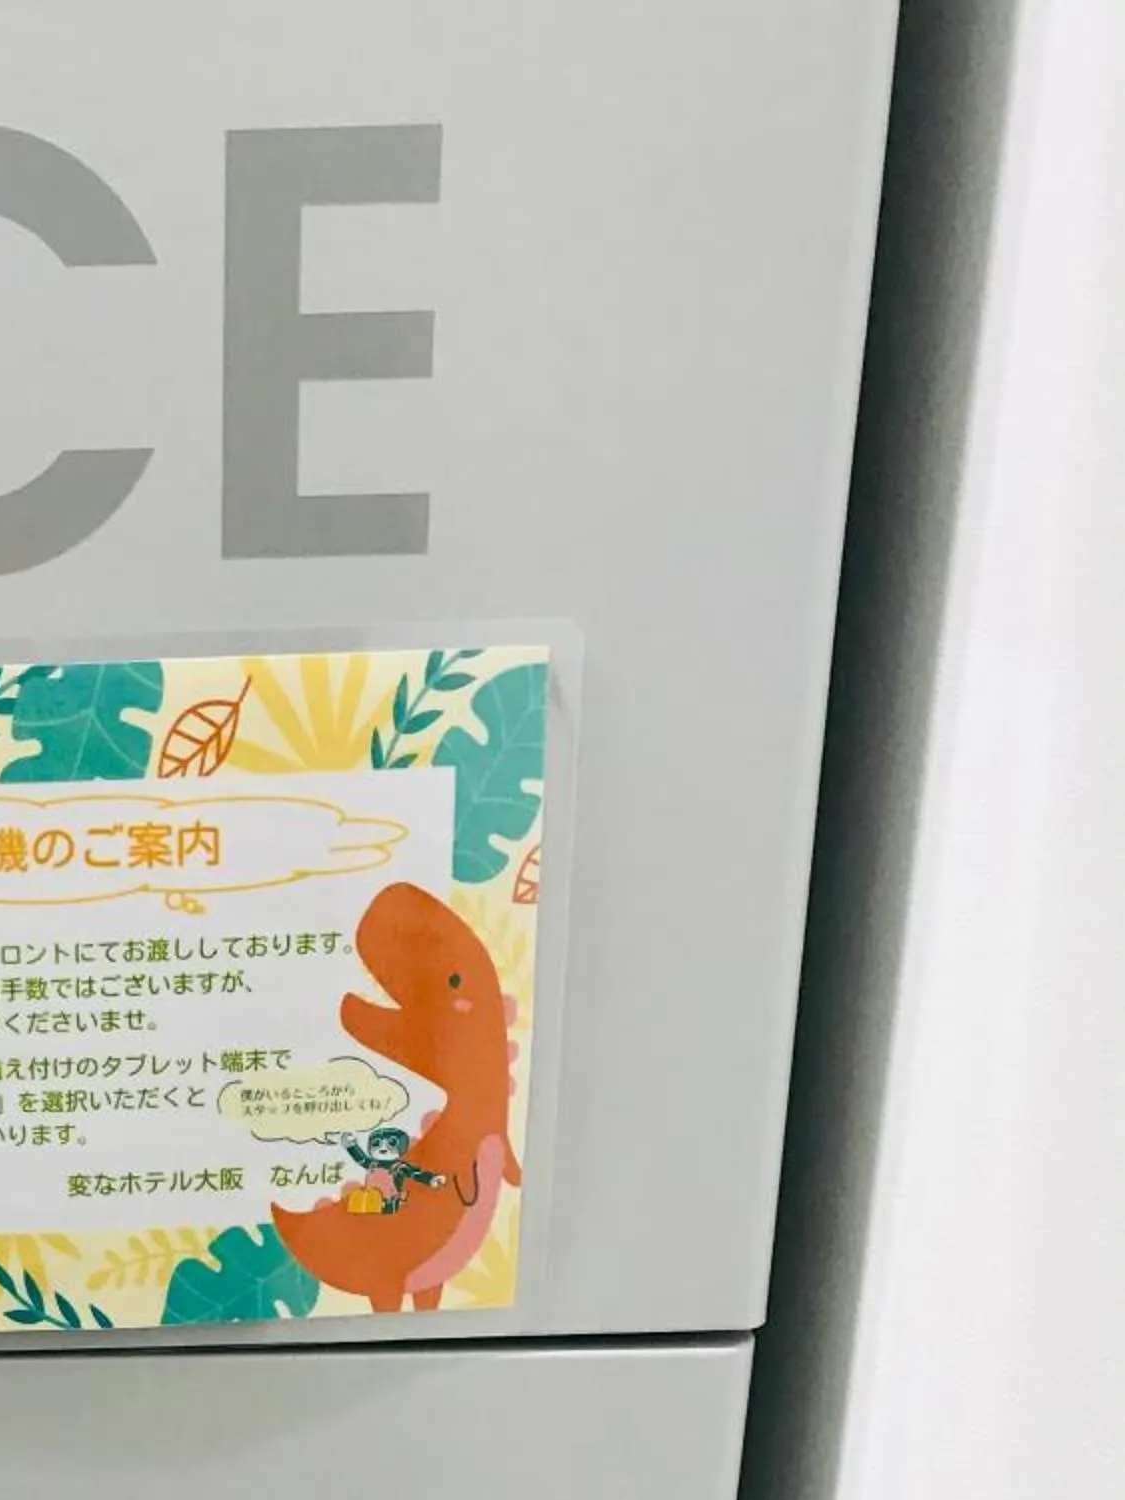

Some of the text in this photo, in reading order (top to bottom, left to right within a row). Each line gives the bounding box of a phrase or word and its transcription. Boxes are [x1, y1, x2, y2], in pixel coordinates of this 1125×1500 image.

[68, 1161, 346, 1198] 変なホテル大阪 なんば
